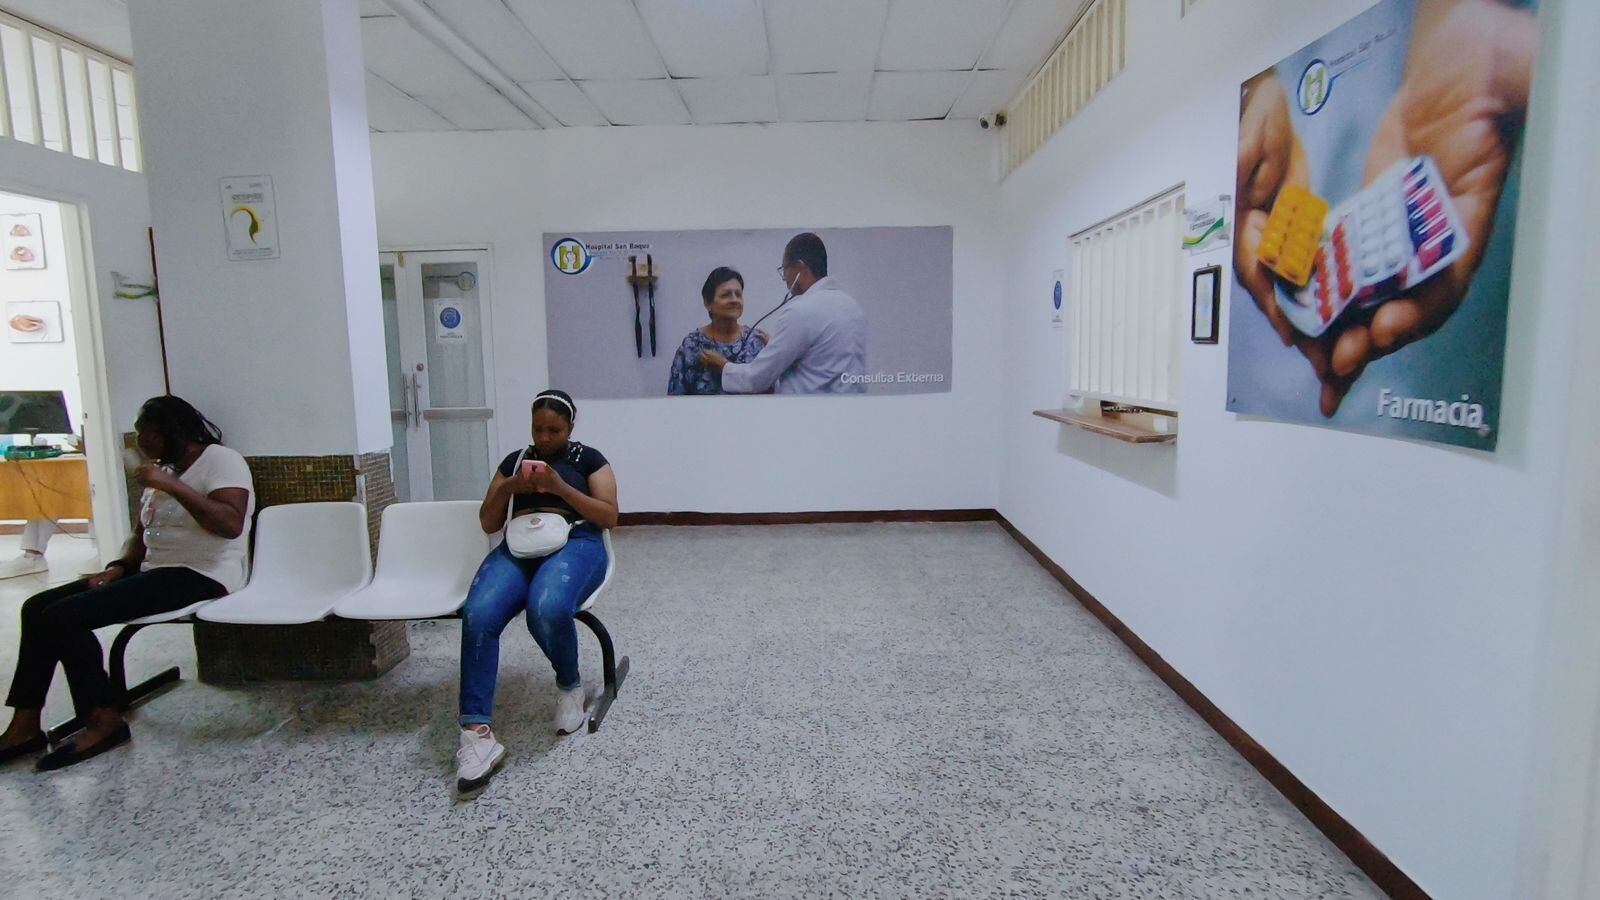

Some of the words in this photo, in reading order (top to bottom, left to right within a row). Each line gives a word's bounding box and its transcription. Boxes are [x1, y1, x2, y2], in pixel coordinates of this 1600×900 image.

[840, 372, 894, 384] Consulta
[897, 371, 944, 383] Externa
[1377, 388, 1482, 428] Farmacia
